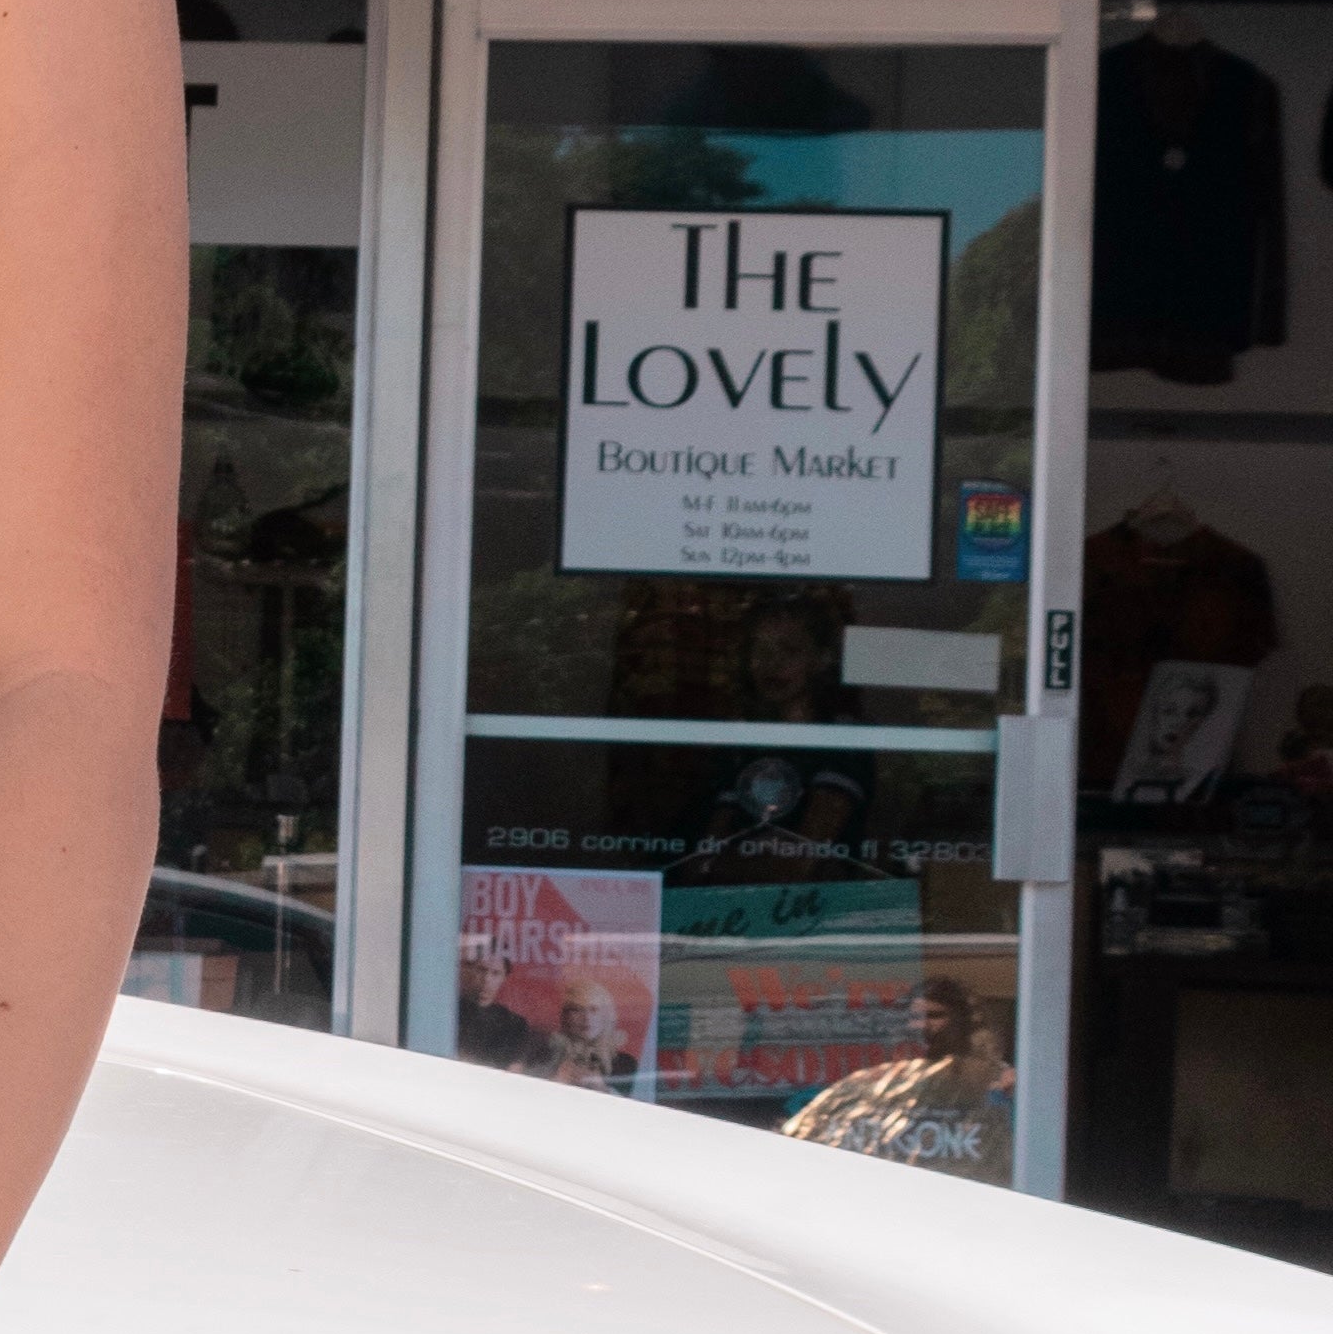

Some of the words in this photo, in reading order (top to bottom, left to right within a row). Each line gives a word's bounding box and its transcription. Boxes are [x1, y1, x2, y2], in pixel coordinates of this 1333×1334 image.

[1050, 613, 1069, 688] PULL
[487, 825, 570, 850] 2906
[740, 838, 850, 859] orlando
[470, 873, 542, 917] BOY
